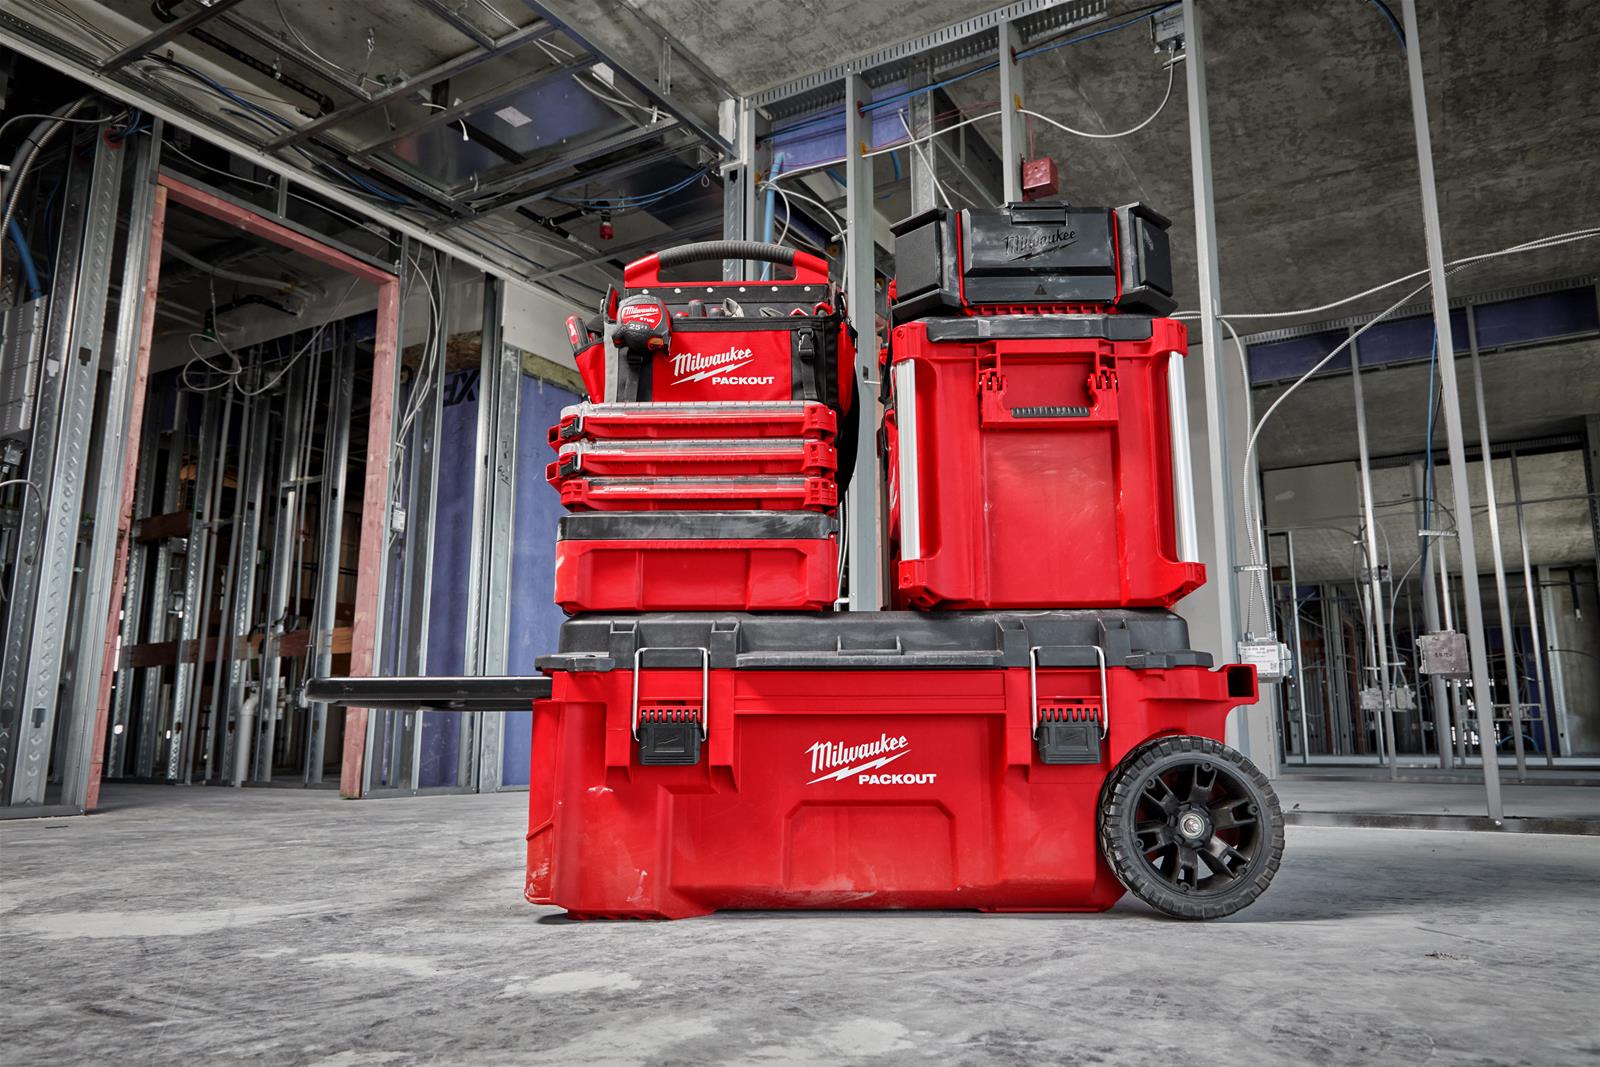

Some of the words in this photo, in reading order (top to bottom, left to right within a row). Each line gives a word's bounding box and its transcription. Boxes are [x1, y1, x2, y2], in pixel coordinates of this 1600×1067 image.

[1001, 229, 1076, 257] Milwaukee
[623, 306, 659, 316] Milwaukee
[669, 346, 753, 377] Milwaukee
[712, 377, 775, 385] PACKOUT
[804, 733, 909, 774] Milwaukee
[858, 774, 937, 785] PACKOUT
